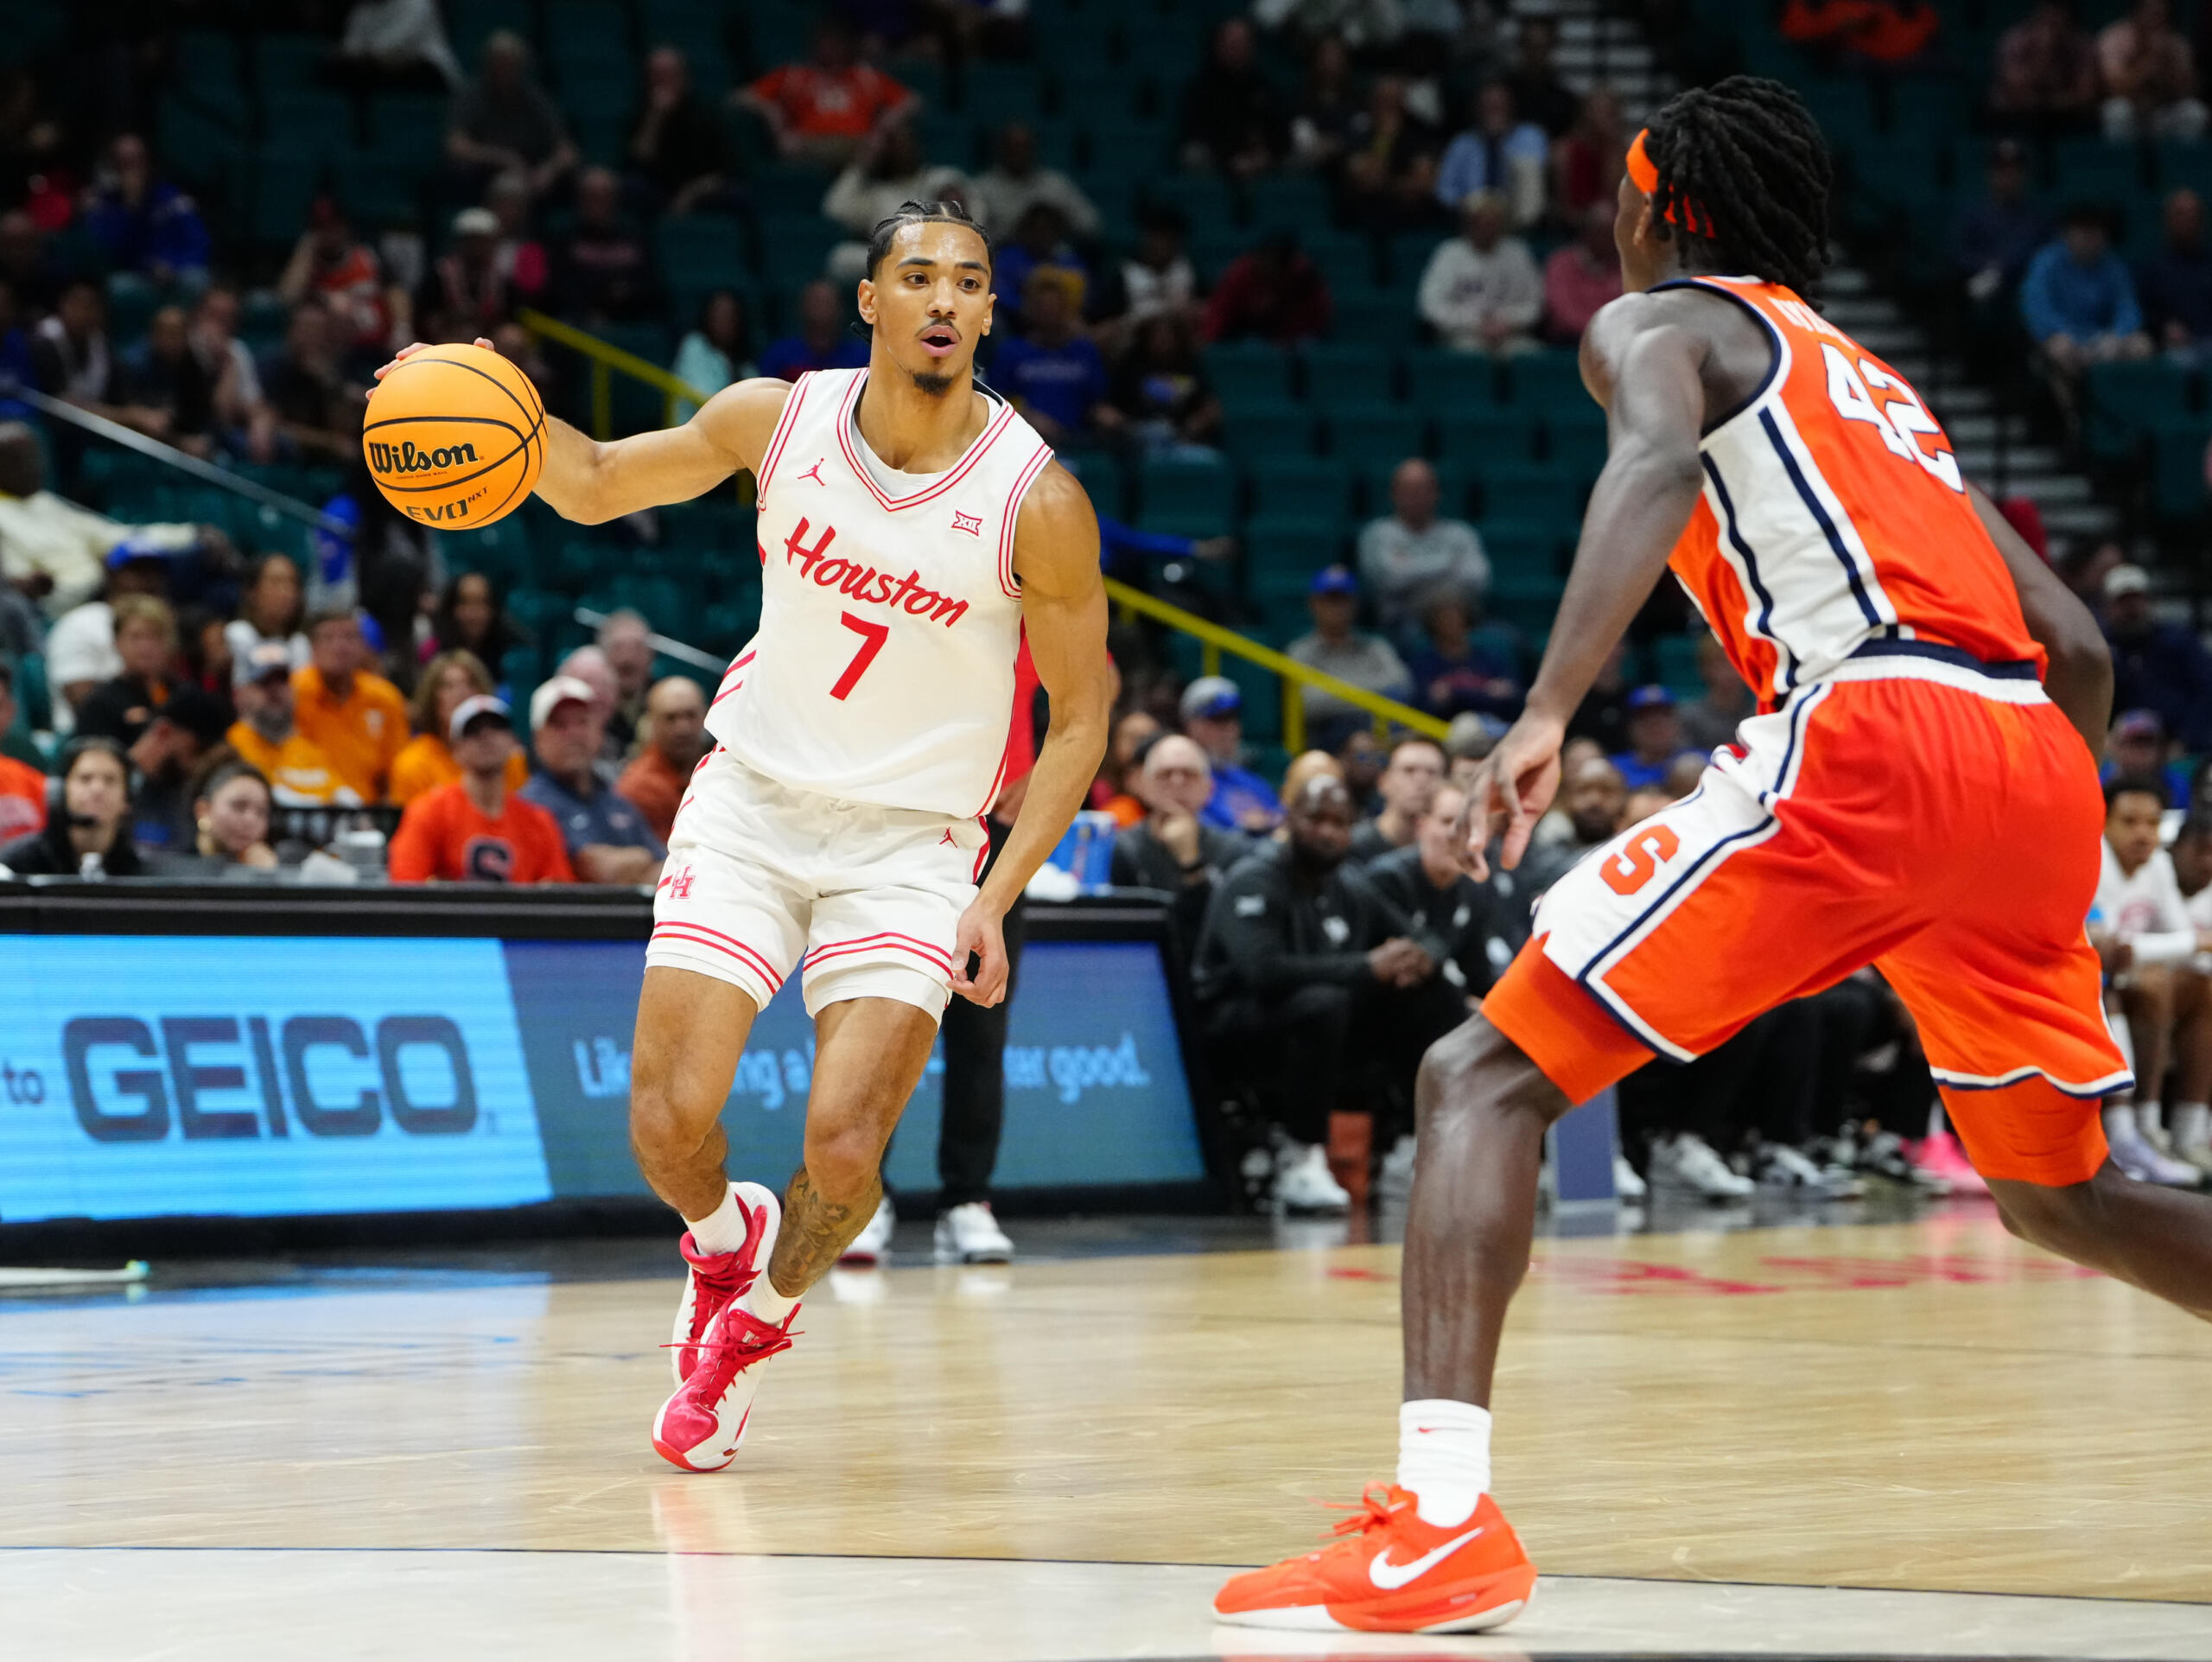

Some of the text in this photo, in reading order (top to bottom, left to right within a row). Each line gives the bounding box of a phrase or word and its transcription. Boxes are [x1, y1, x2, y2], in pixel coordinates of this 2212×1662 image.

[368, 441, 478, 474] Wilson
[1819, 341, 1965, 494] 42
[784, 516, 969, 628] Houston
[830, 610, 890, 701] 7
[1599, 824, 1680, 895] S
[3, 1015, 479, 1143] to GEICO
